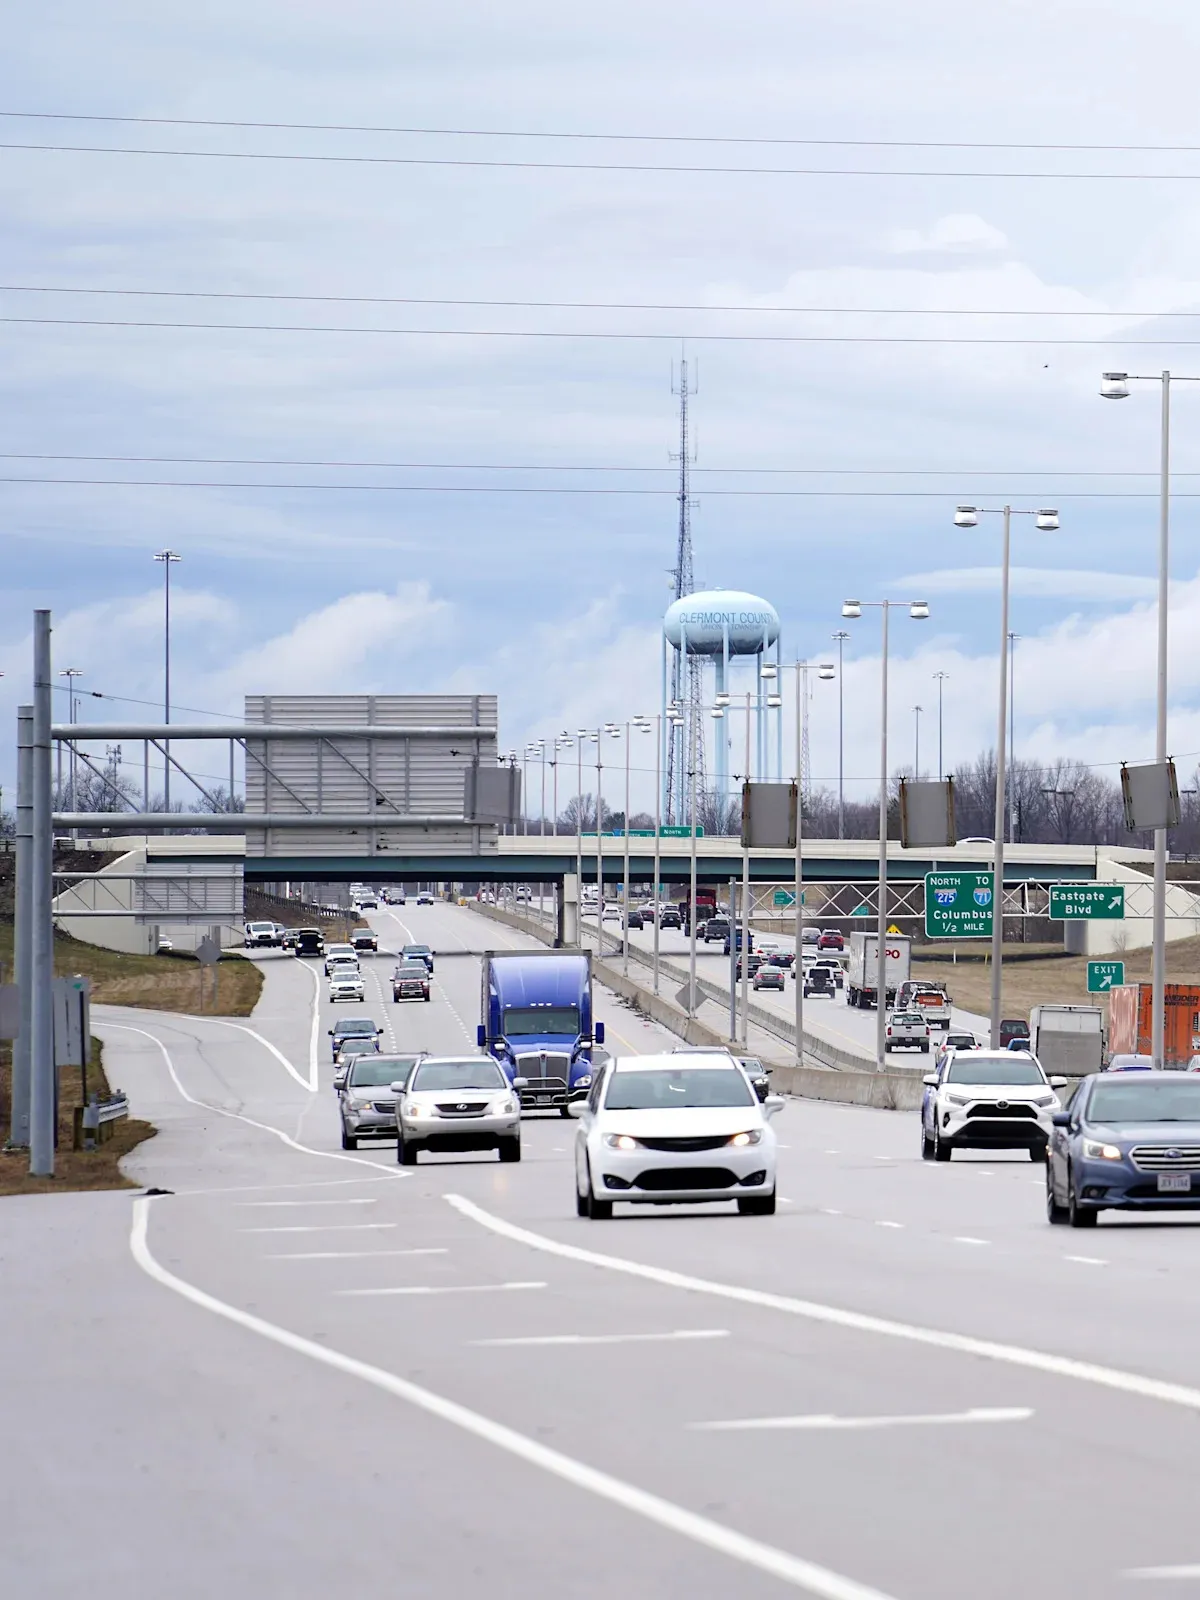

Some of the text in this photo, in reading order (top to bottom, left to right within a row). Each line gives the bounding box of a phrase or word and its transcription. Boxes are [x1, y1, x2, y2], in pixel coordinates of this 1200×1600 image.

[679, 612, 771, 623] CLERMONT COUNT
[930, 877, 989, 885] NORTH TO
[937, 893, 990, 905] 275 71
[1052, 891, 1105, 903] Eastgate
[1065, 905, 1092, 914] Blvd
[933, 910, 992, 920] Columbus
[942, 922, 985, 933] 1/2 MILE
[1094, 966, 1117, 974] EXIT
